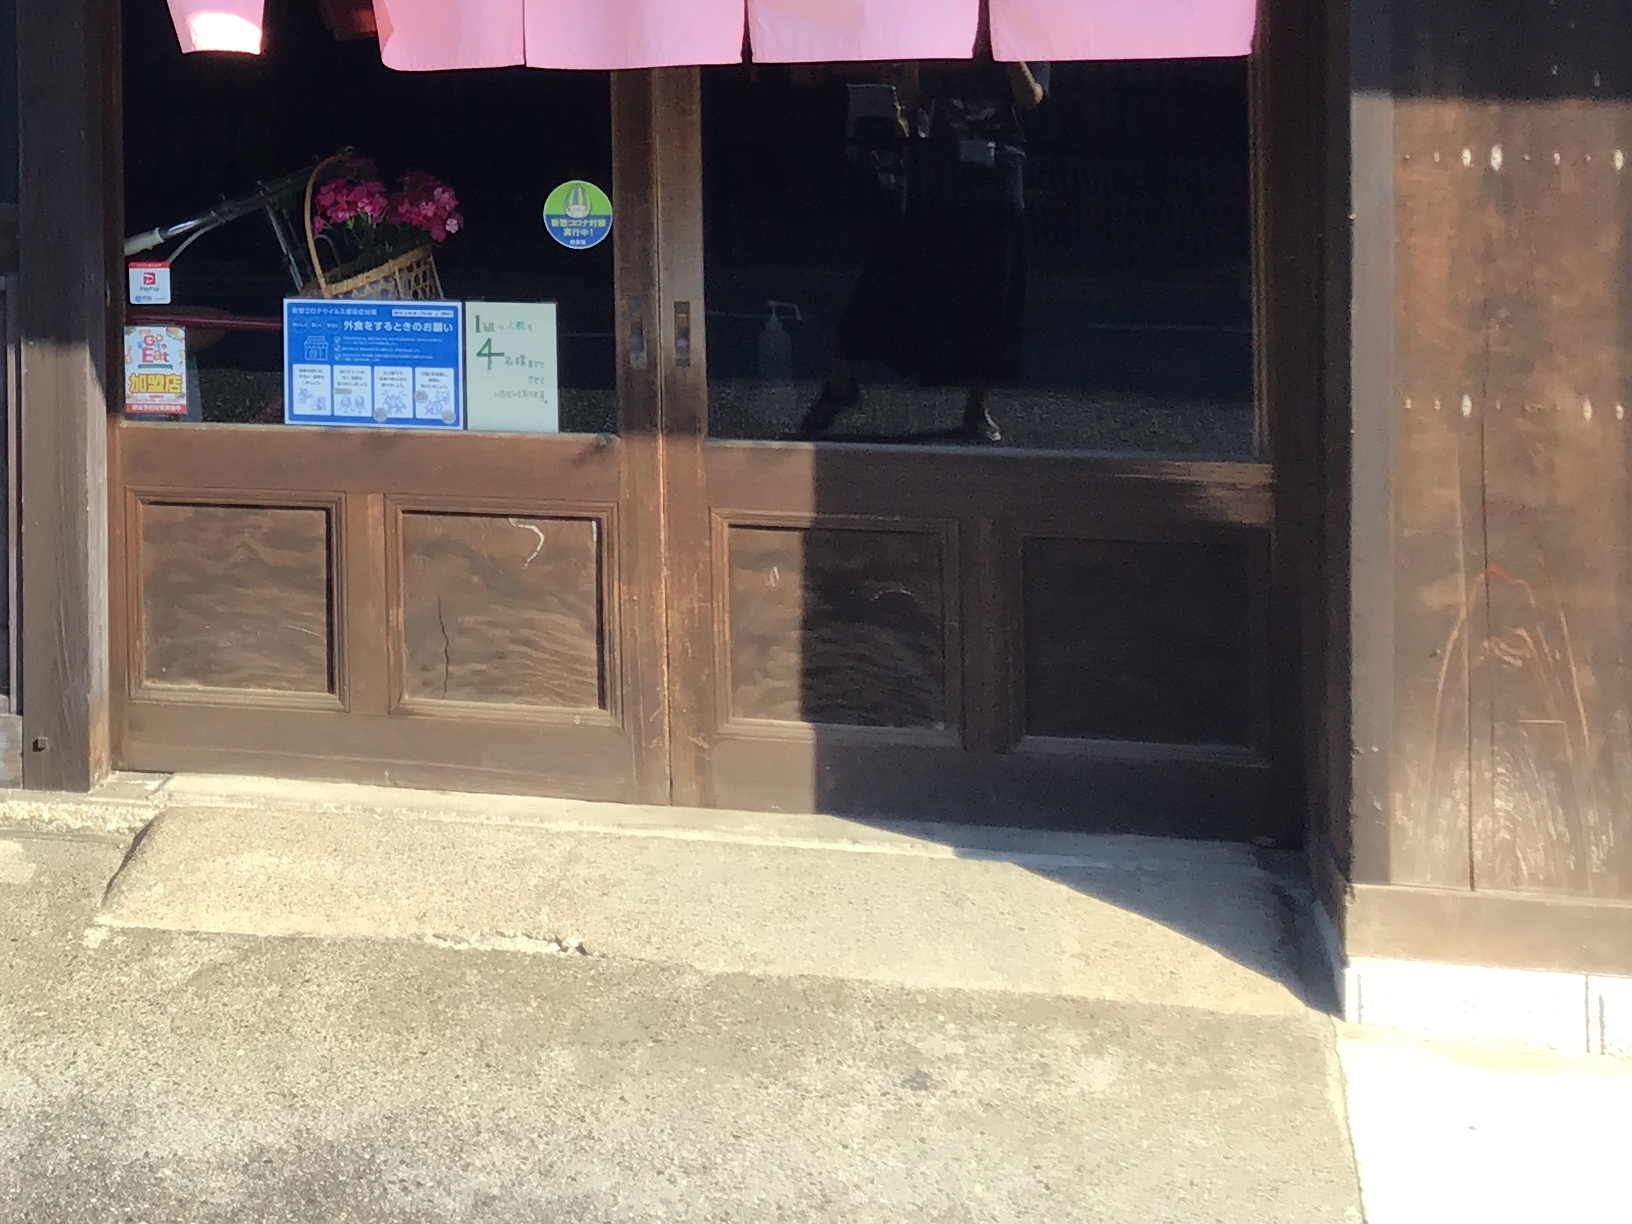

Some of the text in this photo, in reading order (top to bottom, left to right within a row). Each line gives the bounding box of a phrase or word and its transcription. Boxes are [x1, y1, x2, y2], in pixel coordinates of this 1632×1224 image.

[343, 320, 454, 333] 外食をするときのお願い
[143, 333, 164, 346] Go
[142, 348, 170, 363] Eat
[129, 373, 183, 394] 加盟店
